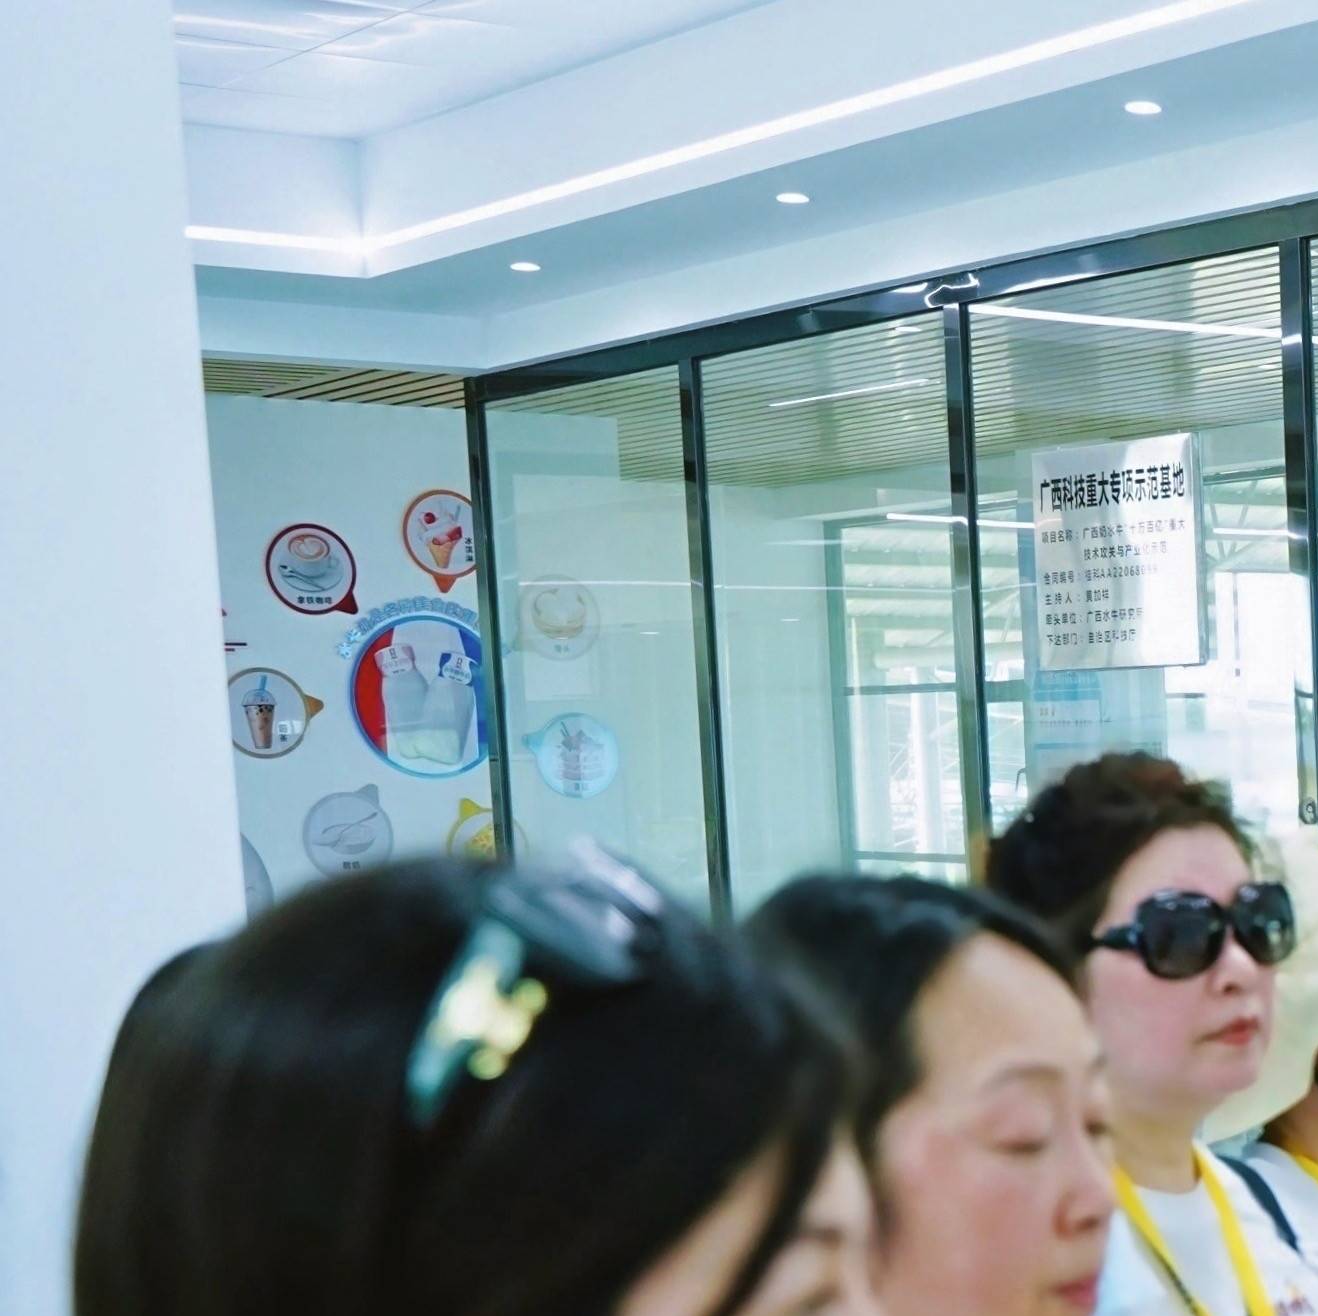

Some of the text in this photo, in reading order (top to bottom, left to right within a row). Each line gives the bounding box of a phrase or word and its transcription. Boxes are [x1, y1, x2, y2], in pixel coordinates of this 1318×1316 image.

[1040, 461, 1186, 513] 广西科技重大专项示范基地
